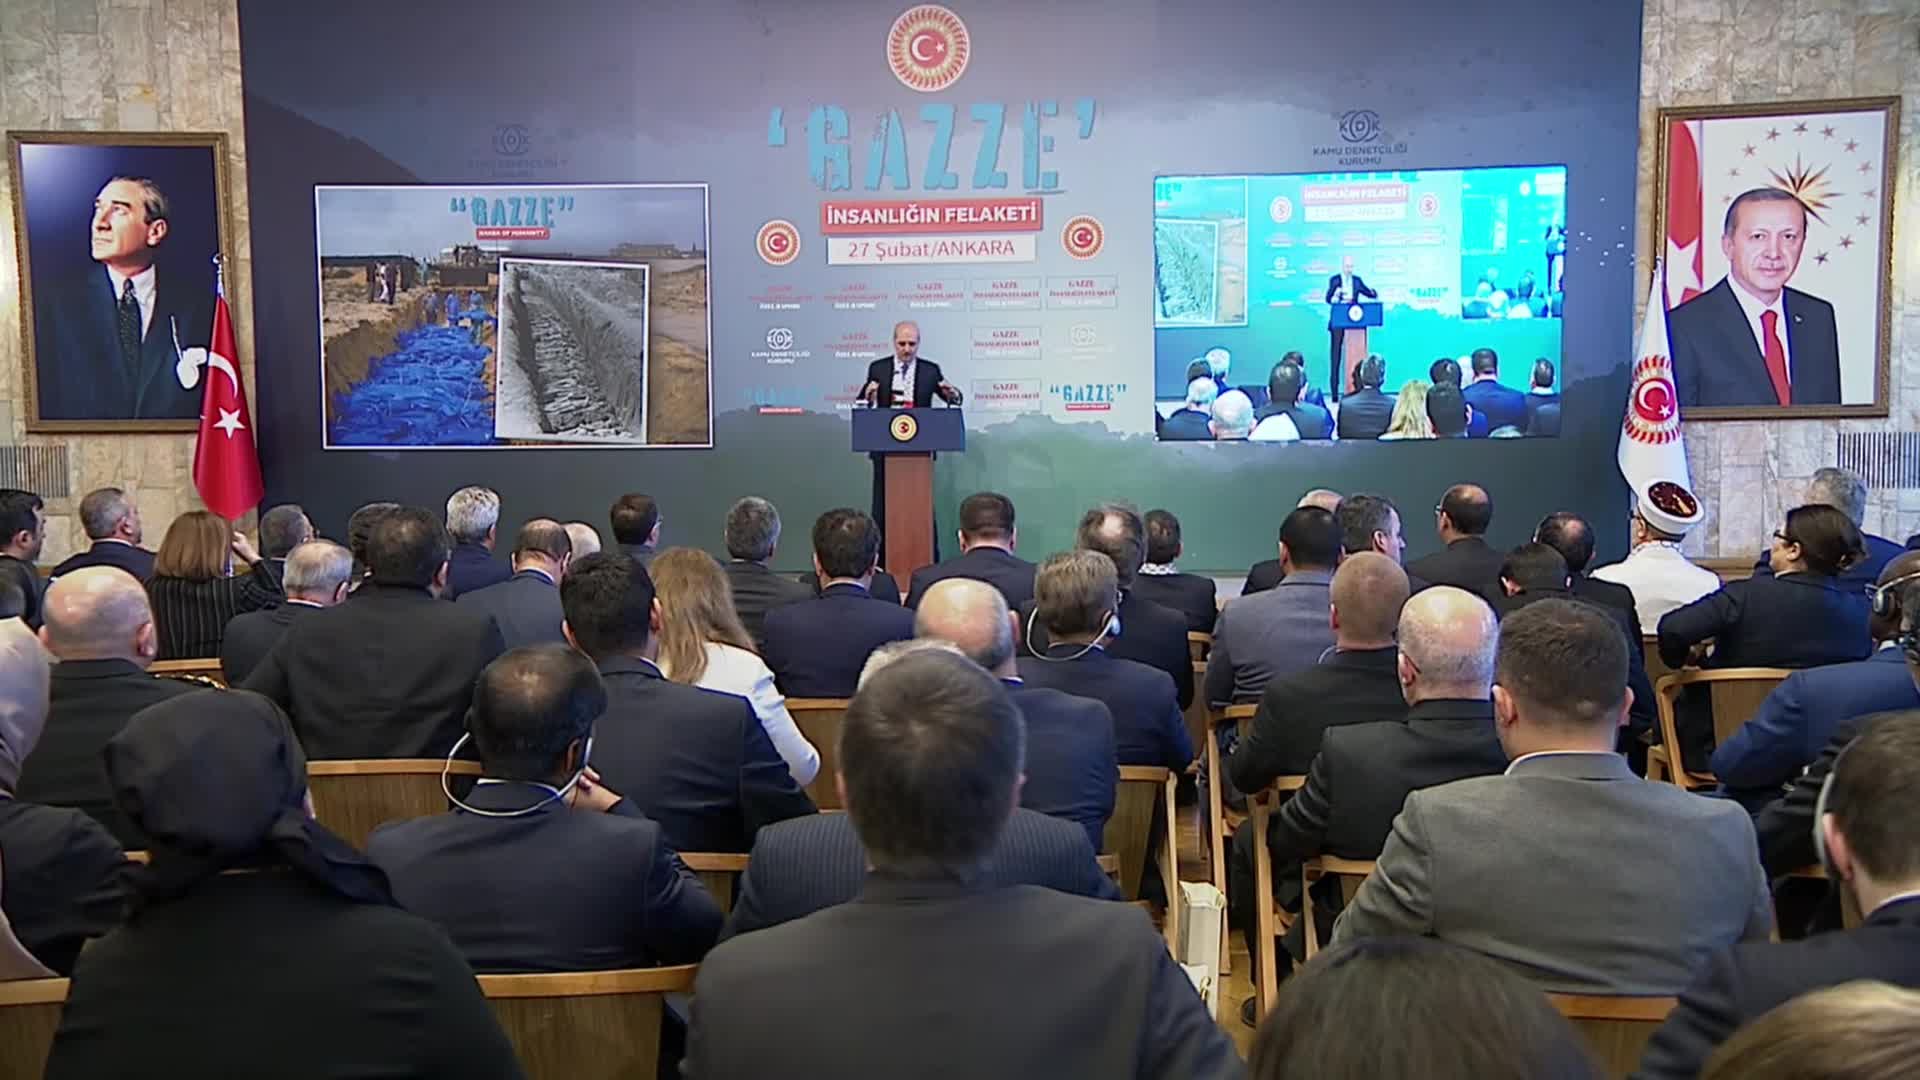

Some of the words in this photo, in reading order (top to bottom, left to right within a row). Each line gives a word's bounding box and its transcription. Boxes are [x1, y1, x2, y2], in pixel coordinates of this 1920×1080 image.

[827, 204, 940, 225] İNSANLIĞIN
[944, 202, 1036, 223] FELAKETİ
[848, 241, 870, 258] 27
[875, 239, 1016, 261] Şubat/ANKARA
